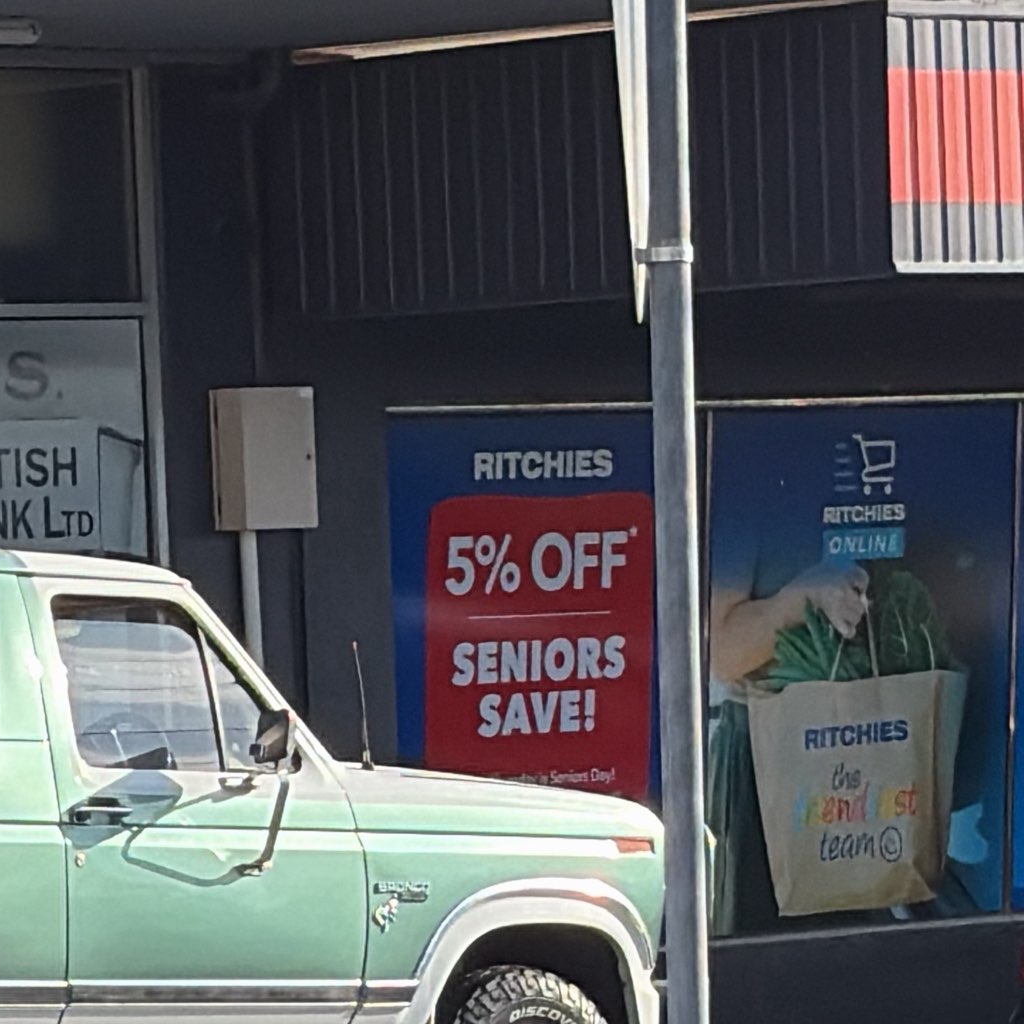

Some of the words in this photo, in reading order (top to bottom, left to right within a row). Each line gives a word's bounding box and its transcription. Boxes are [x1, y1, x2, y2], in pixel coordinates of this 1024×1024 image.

[474, 449, 614, 481] RITCHIES
[822, 503, 906, 524] RITCHIES
[828, 534, 898, 555] ONLINE
[444, 533, 522, 596] 5%
[451, 634, 627, 687] SENIORS
[477, 689, 596, 739] SAVE!
[804, 719, 909, 750] RITCHIES
[831, 762, 862, 791] the
[819, 831, 875, 861] team
